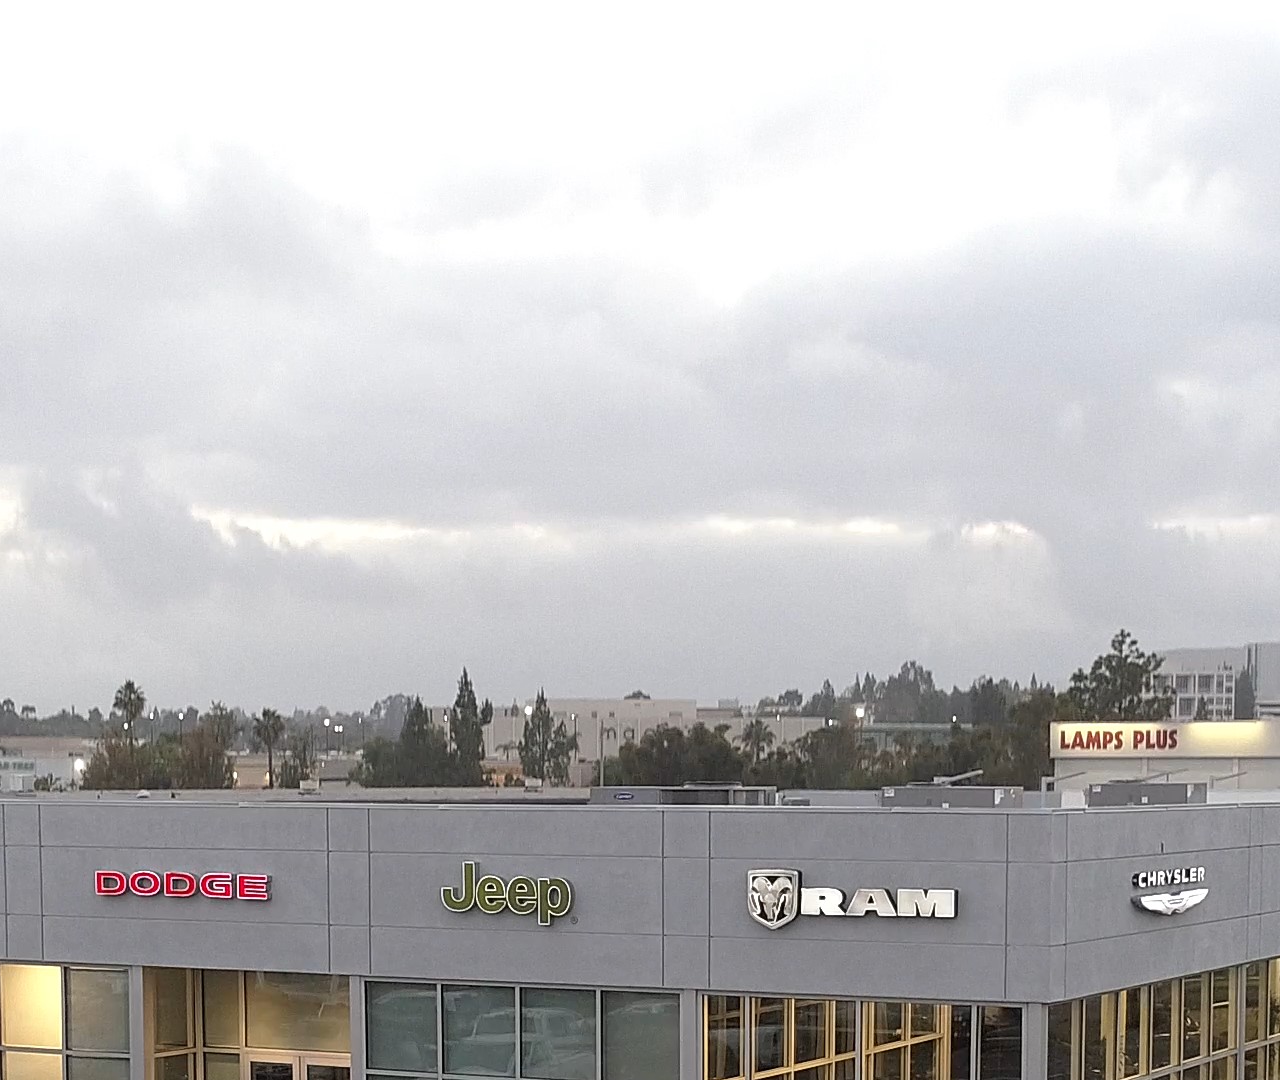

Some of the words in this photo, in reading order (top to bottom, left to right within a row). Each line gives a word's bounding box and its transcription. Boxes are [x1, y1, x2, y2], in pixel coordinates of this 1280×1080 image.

[1060, 730, 1123, 750] LAMPS
[1132, 729, 1178, 749] PLUS
[94, 870, 268, 900] DODGE
[1137, 866, 1206, 888] CHRYSLER
[440, 861, 571, 925] Jeep
[800, 887, 956, 918] RAM
